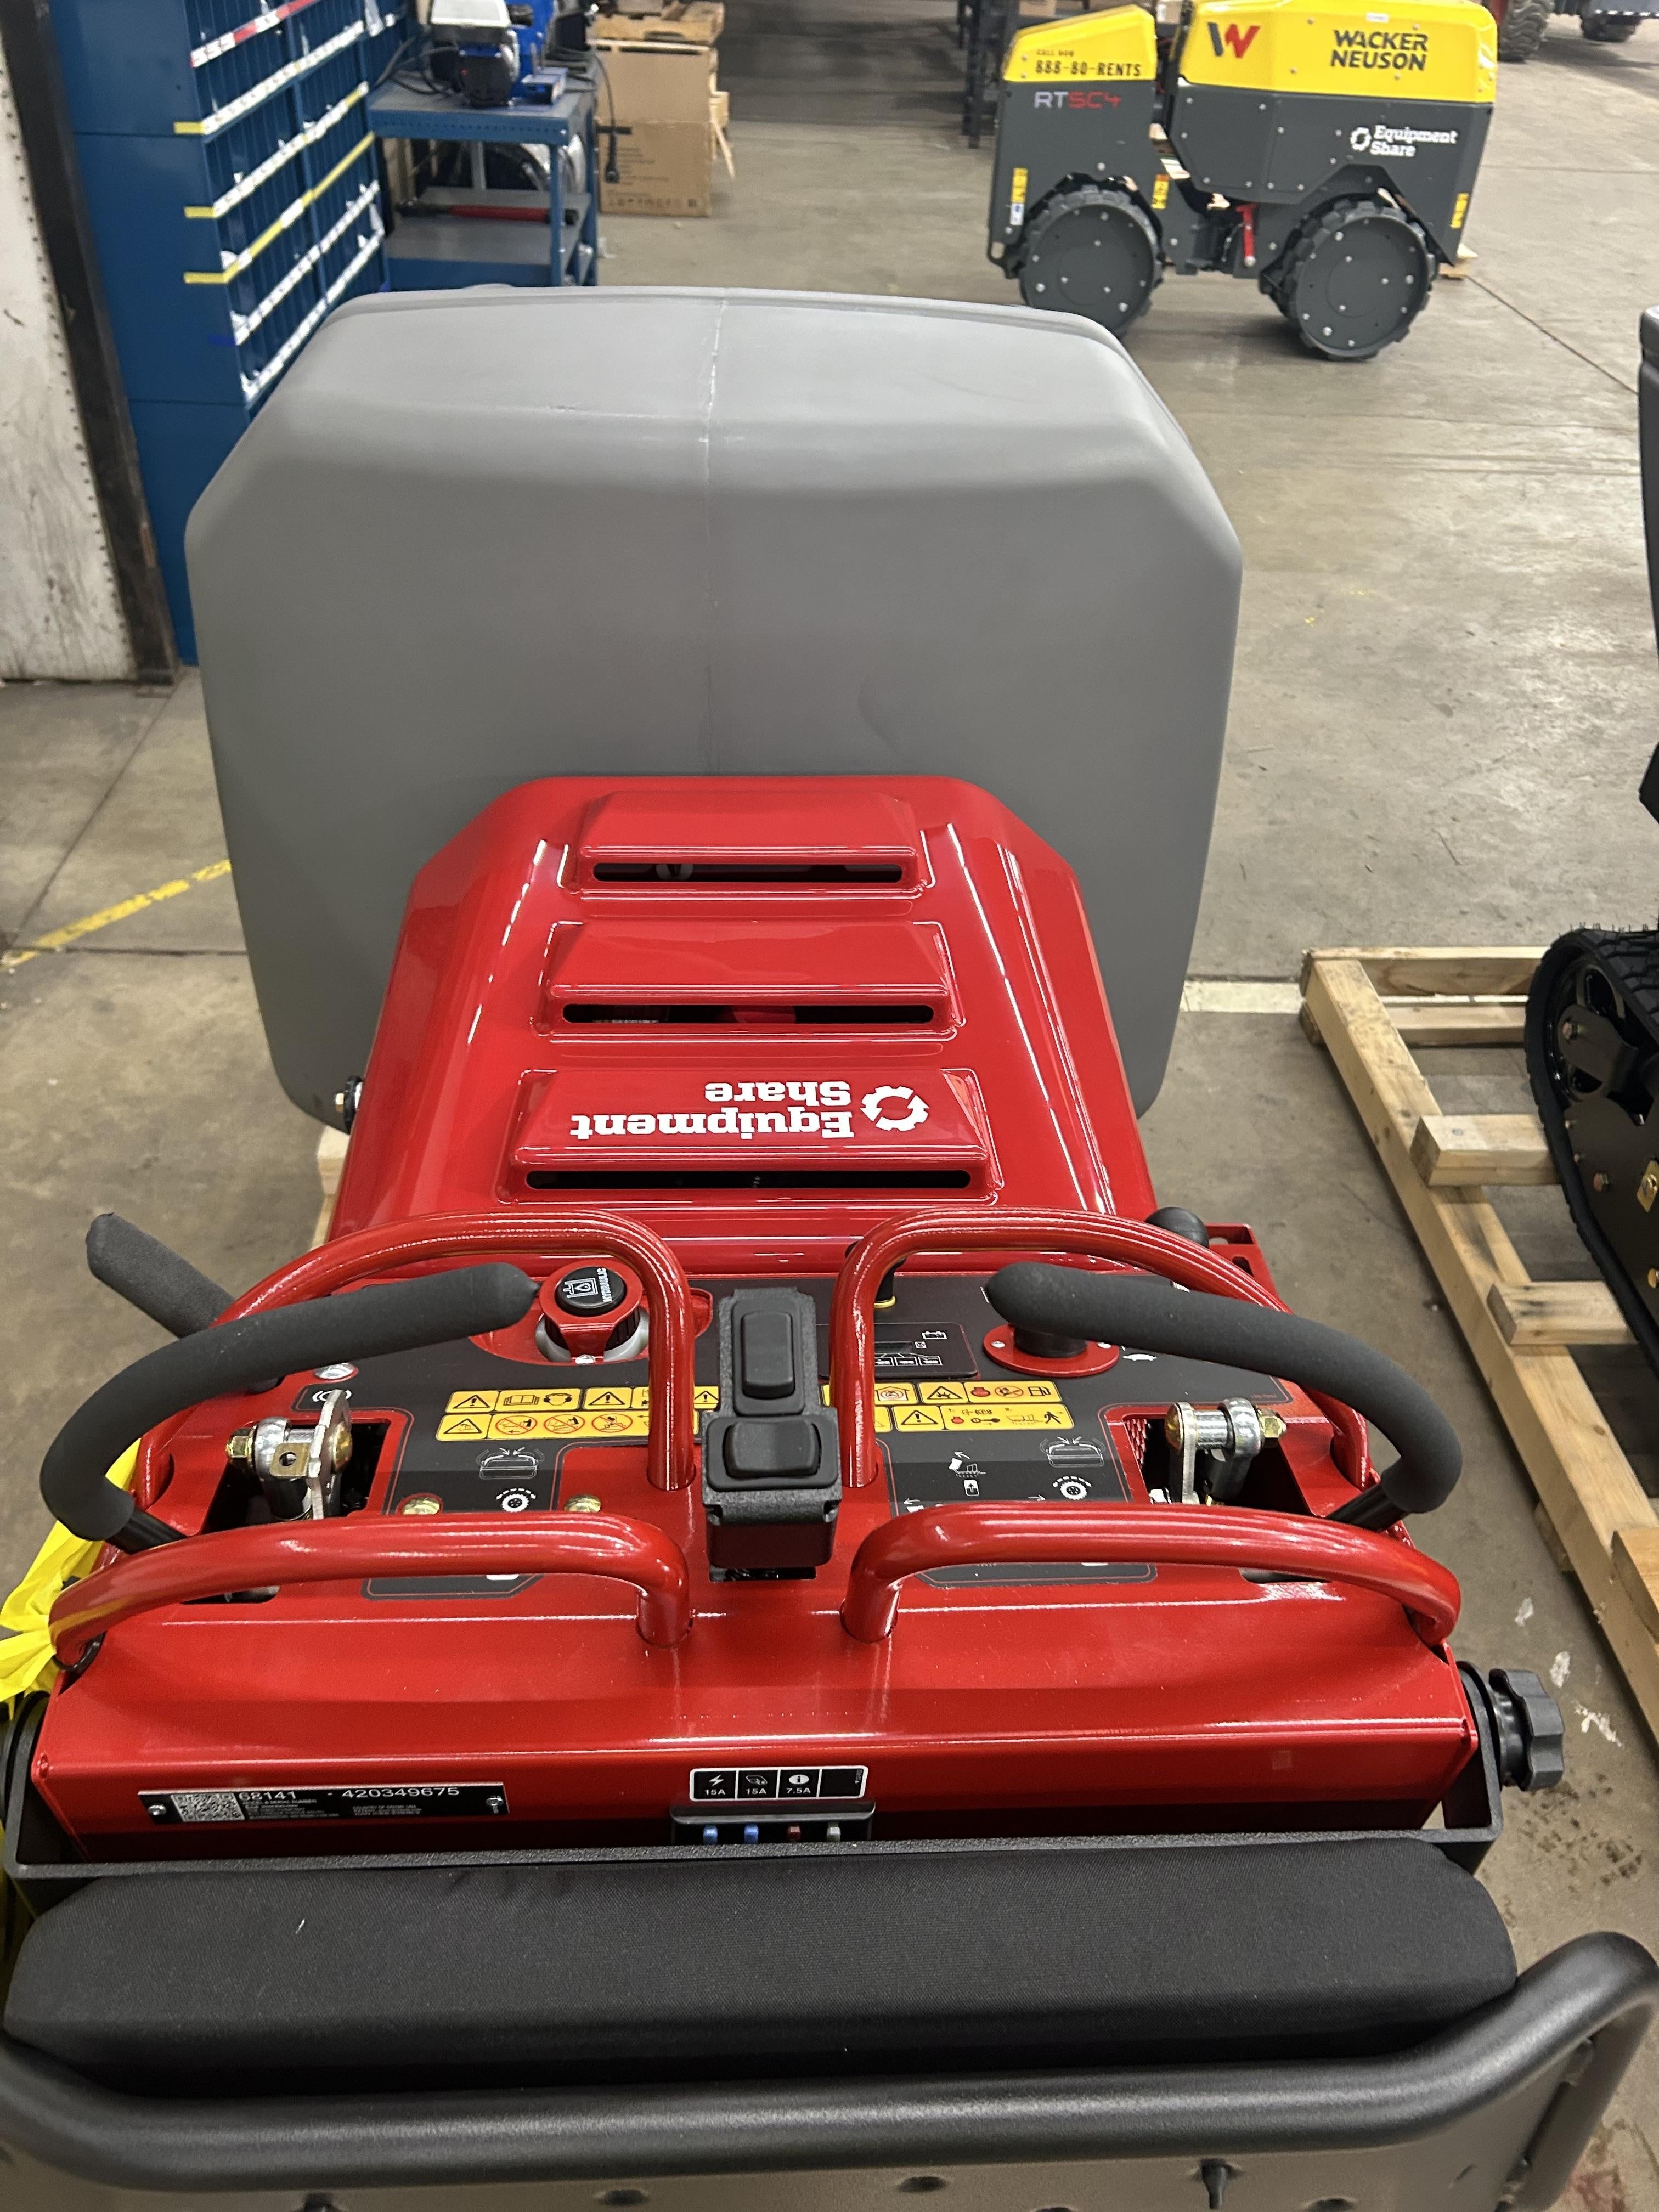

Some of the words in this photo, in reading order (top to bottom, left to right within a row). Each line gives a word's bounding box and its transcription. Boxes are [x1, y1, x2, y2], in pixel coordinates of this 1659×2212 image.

[1334, 30, 1429, 52] WACKER
[1035, 60, 1142, 76] 888-80-RENTS
[1330, 50, 1427, 71] NEUSON
[1373, 125, 1459, 144] Equipment
[1370, 141, 1417, 157] Share
[704, 1081, 851, 1107] Share
[569, 1107, 855, 1140] Equipment
[596, 1268, 613, 1302] HYDRAULIC
[342, 1787, 460, 1798] 420349675
